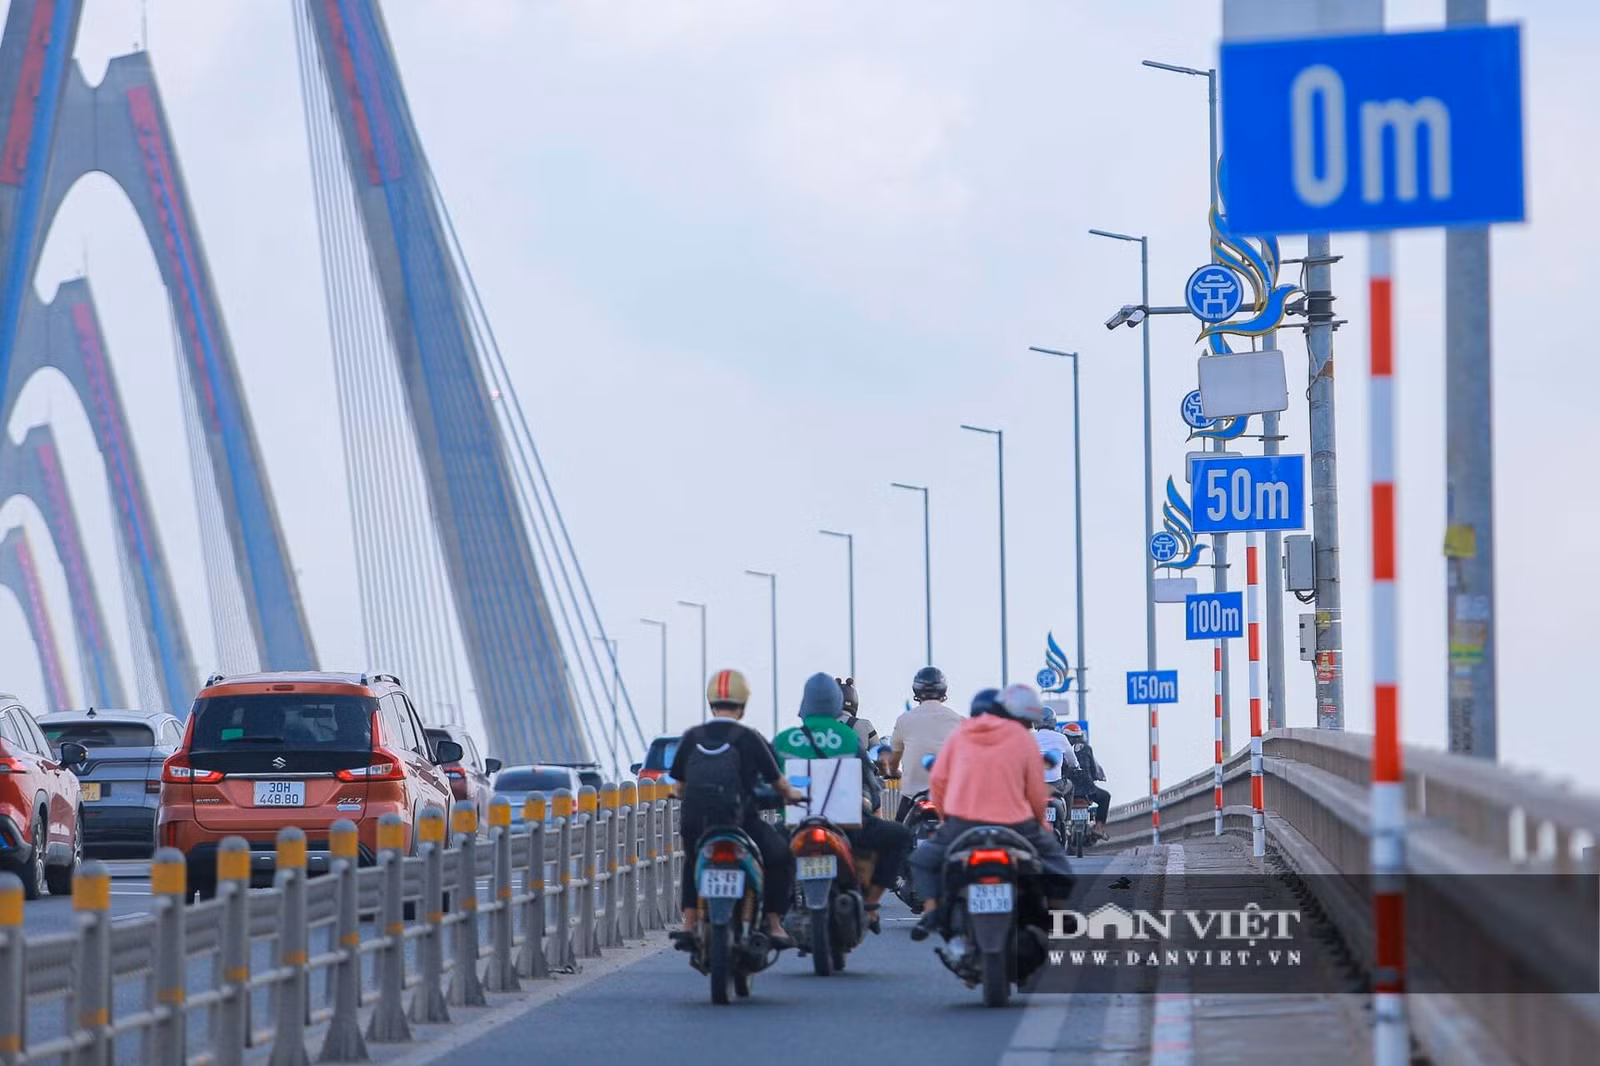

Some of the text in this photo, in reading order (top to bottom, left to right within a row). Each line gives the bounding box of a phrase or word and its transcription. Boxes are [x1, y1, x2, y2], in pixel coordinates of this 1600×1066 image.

[1290, 63, 1453, 208] 0m
[1206, 468, 1290, 522] 50m
[1189, 599, 1240, 634] 100m
[1129, 675, 1176, 701] 150m
[259, 793, 299, 805] 448.80
[269, 782, 291, 793] 30H
